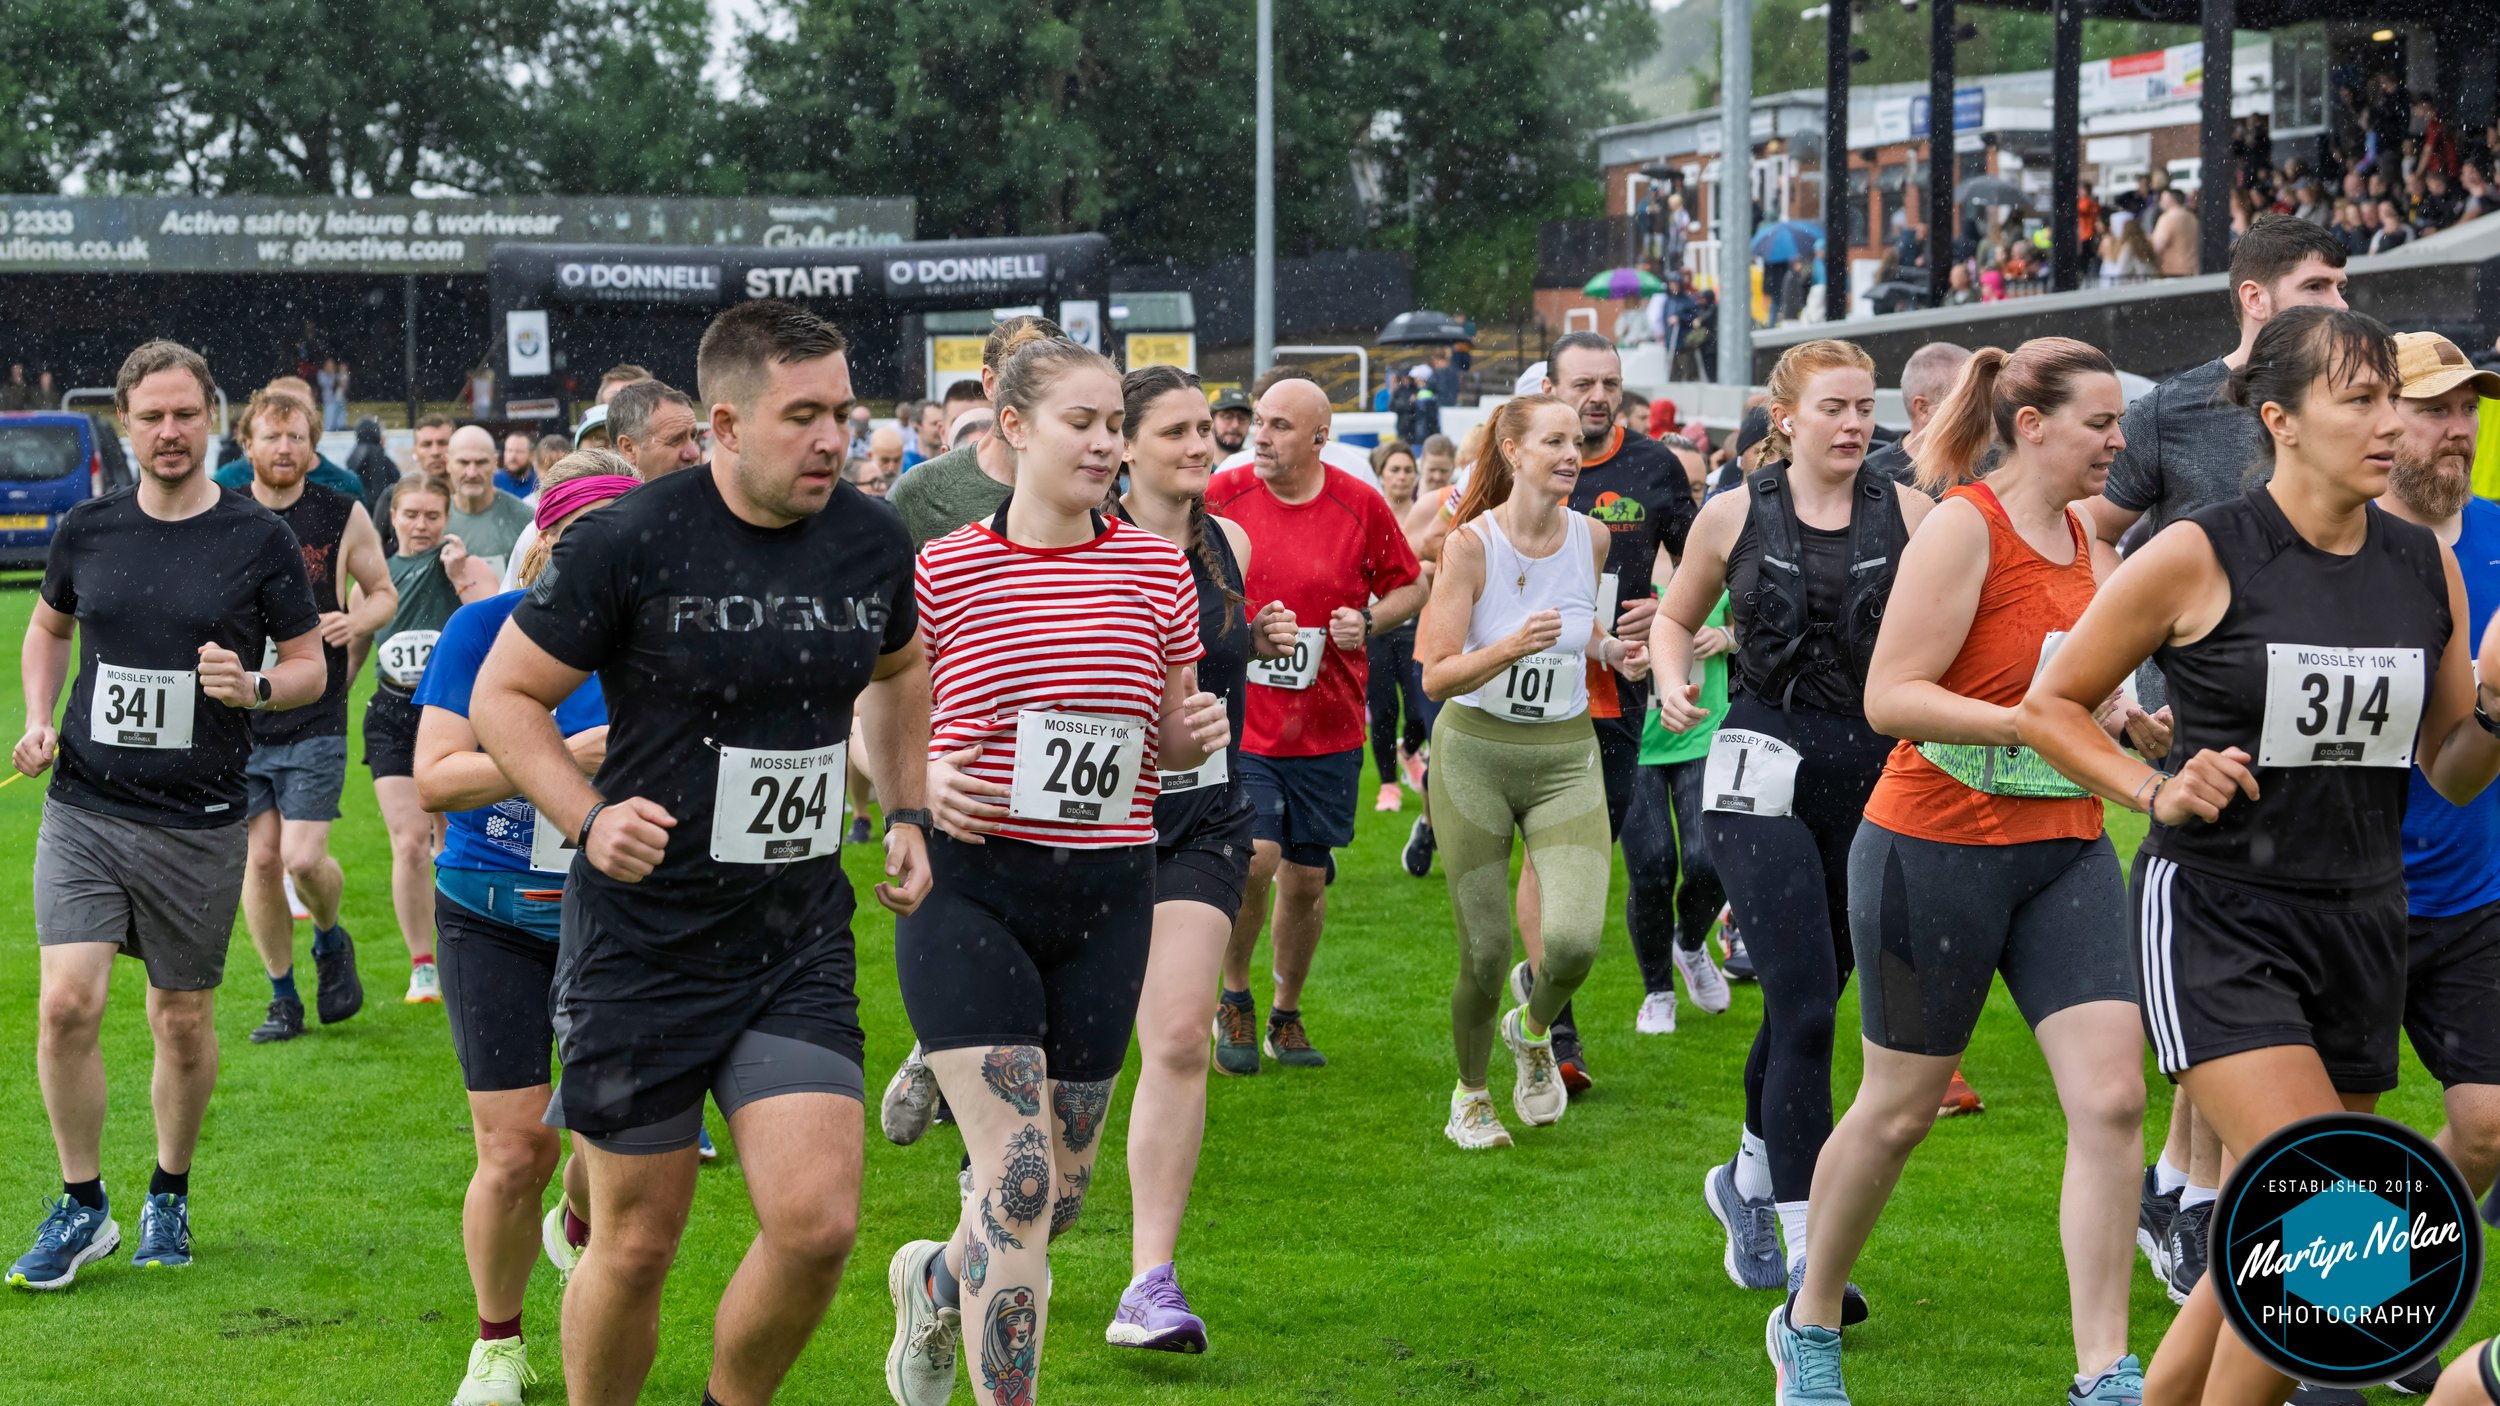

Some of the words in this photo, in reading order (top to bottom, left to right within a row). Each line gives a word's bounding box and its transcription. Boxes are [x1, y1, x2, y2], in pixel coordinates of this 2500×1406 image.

[13, 209, 75, 235] 2333
[159, 209, 240, 236] Active
[243, 209, 322, 239] safety
[325, 209, 409, 235] leisure
[412, 209, 434, 235] &
[437, 209, 563, 236] workwear
[257, 240, 288, 261] w:
[292, 237, 466, 266] gloactive.com
[745, 265, 861, 299] START
[666, 594, 892, 633] ROGUE
[391, 644, 434, 668] 312
[1549, 657, 1563, 666] 10K
[2298, 652, 2365, 668] MOSSLEY
[2370, 655, 2397, 669] 10K
[107, 669, 154, 684] MOSSLEY
[156, 675, 175, 685] 10K
[1506, 665, 1555, 703] 101
[105, 684, 166, 729] 341
[2296, 672, 2390, 737] 314
[1044, 718, 1107, 736] MOSSLEY
[1110, 727, 1130, 740] 10K
[1719, 734, 1763, 746] MOSSLEY
[1764, 740, 1784, 754] 10K
[750, 756, 816, 770] MOSSLEY
[818, 752, 835, 767] 10K
[1042, 737, 1121, 799] 266
[745, 772, 828, 834] 264
